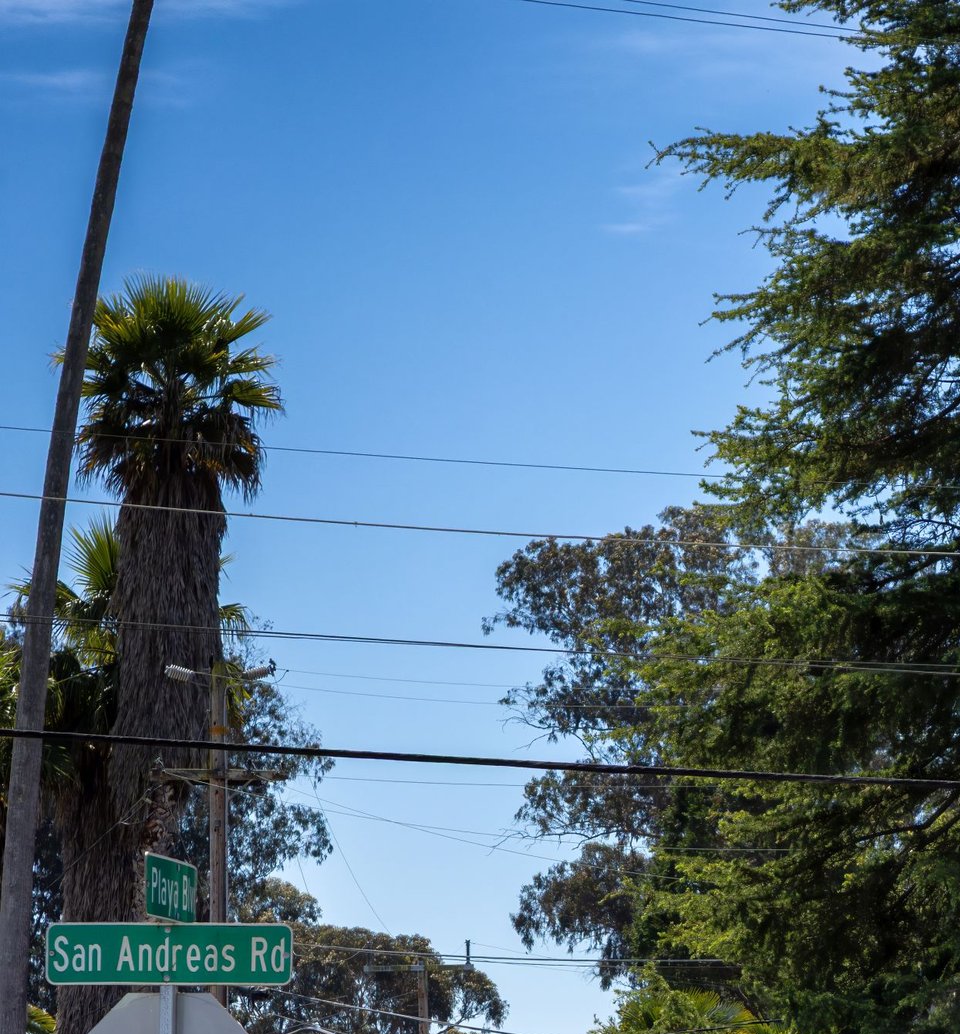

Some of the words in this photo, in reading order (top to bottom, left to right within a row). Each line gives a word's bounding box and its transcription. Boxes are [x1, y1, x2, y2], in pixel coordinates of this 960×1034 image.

[151, 866, 179, 916] Playa
[53, 935, 102, 973] San
[116, 935, 236, 973] Andreas
[250, 936, 286, 973] Rd
